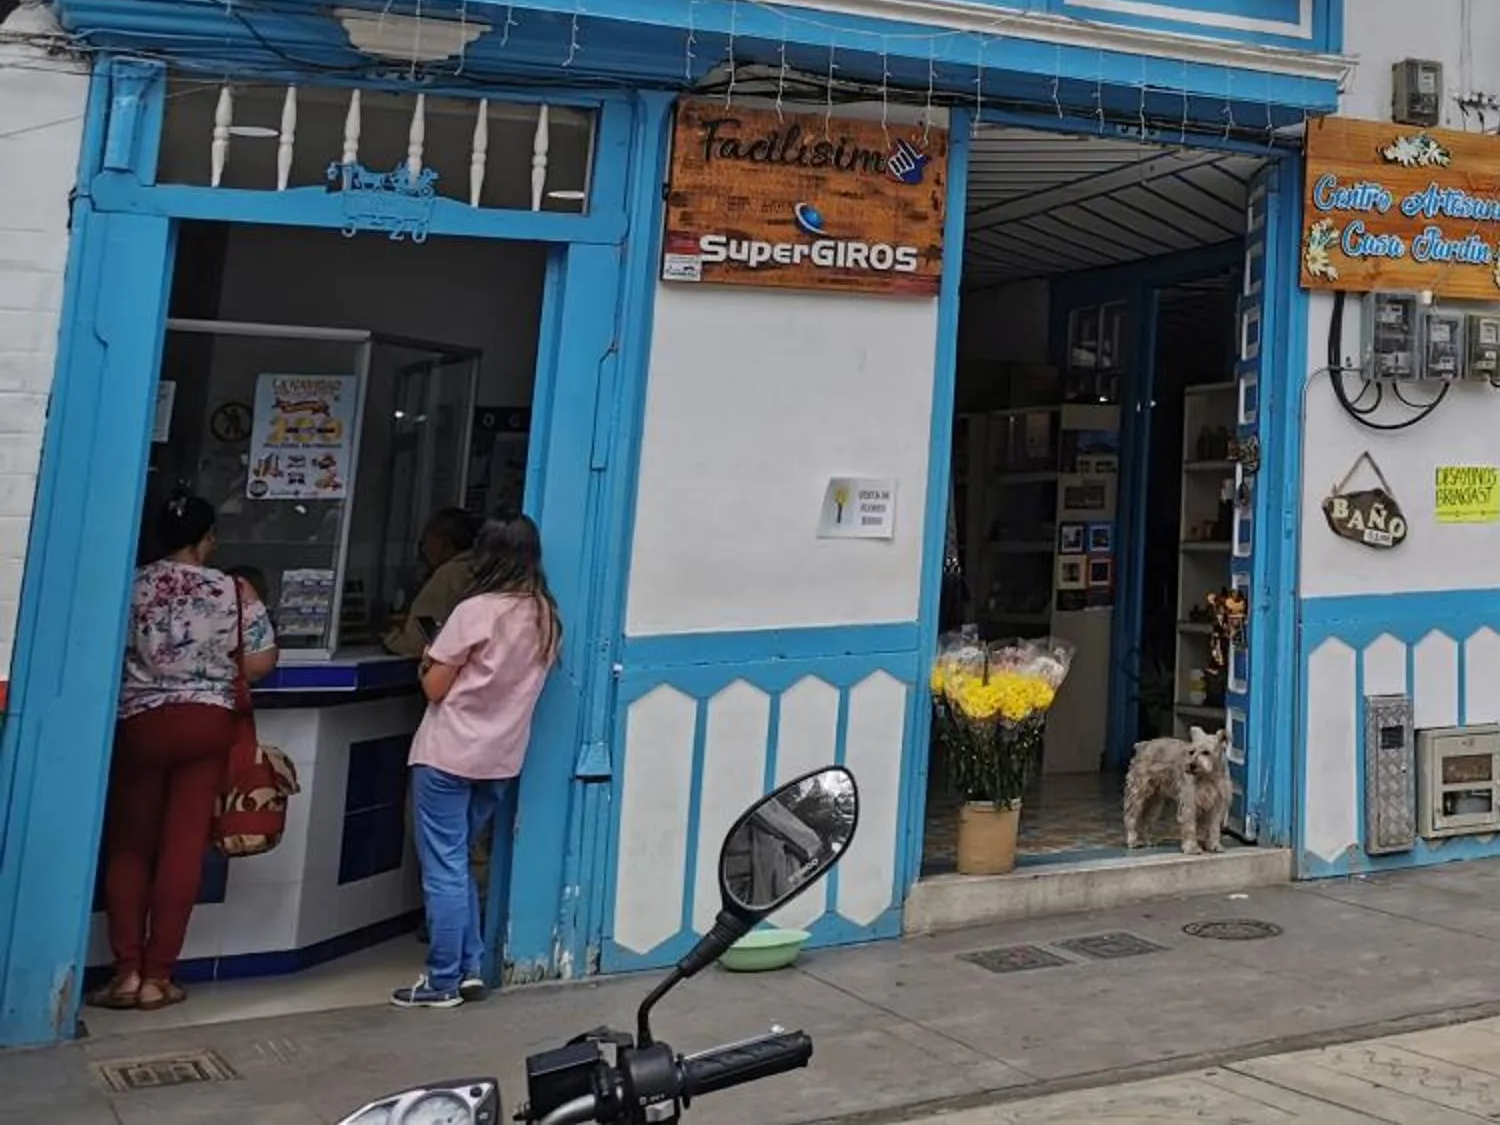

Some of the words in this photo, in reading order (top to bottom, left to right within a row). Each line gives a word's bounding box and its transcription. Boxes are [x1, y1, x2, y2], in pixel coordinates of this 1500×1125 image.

[1313, 174, 1393, 214] Centro
[699, 234, 919, 273] SuperGIROS
[1341, 219, 1405, 257] Casa
[1330, 497, 1406, 538] BAÑO
